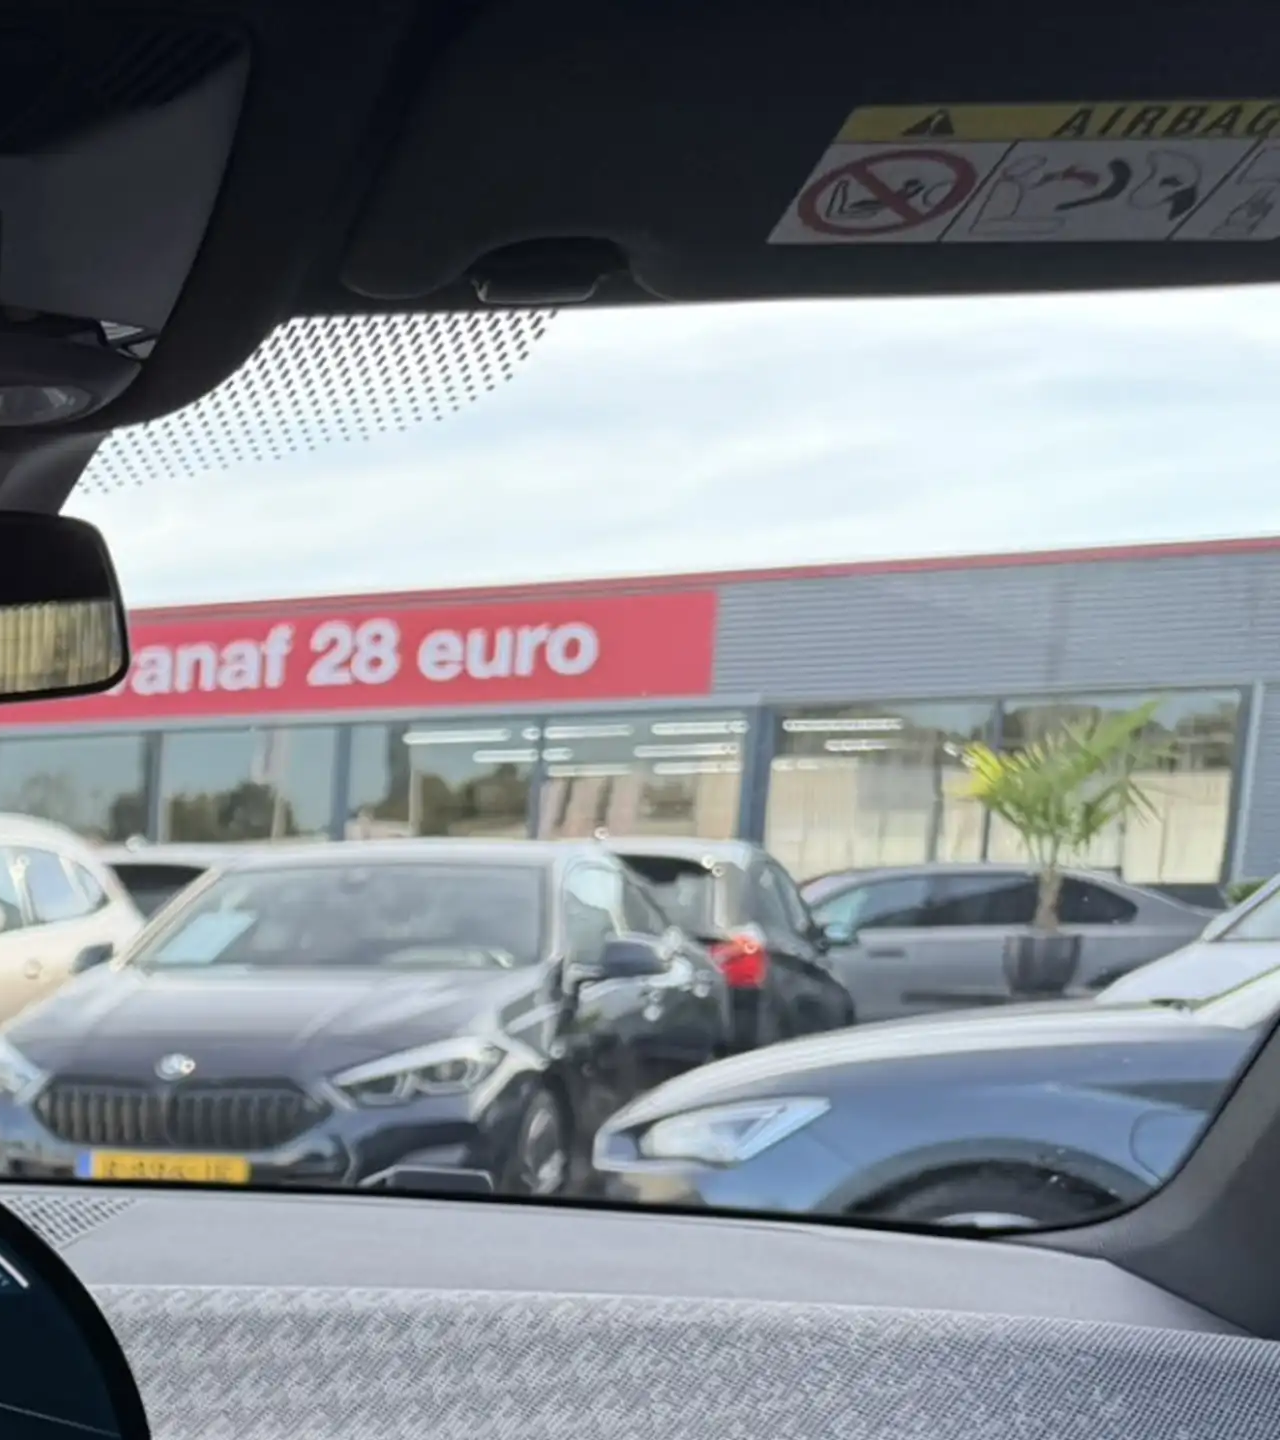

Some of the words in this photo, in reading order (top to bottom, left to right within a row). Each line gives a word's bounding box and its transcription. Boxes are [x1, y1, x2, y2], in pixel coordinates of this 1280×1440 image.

[102, 624, 293, 697] anaf
[306, 617, 402, 687] 28
[417, 621, 600, 680] euro
